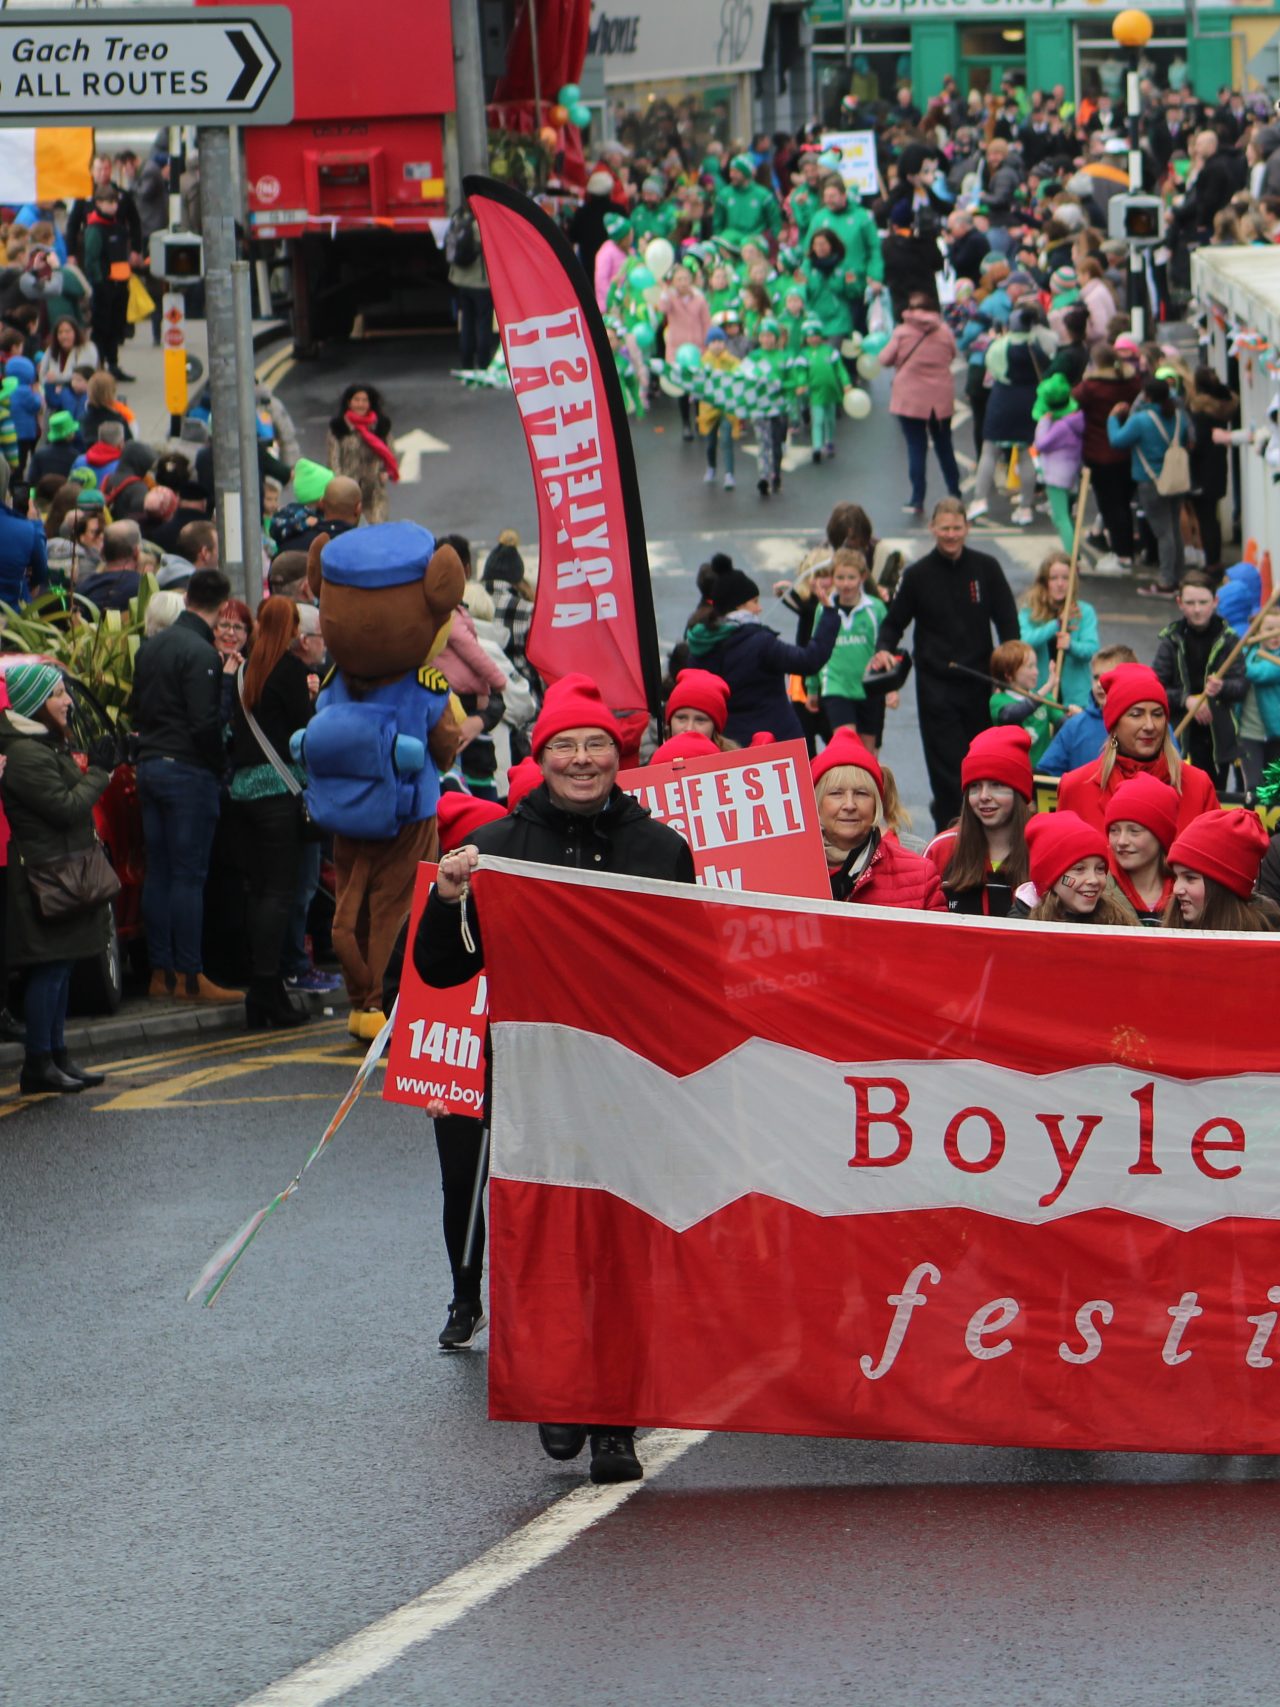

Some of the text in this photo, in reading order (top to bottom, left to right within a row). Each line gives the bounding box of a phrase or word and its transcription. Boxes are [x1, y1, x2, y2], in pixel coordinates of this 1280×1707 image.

[12, 37, 168, 62] Gach Treo
[15, 73, 71, 97] ALL
[83, 71, 208, 96] ROUTES
[408, 1019, 481, 1069] 14th
[844, 1076, 1246, 1207] Boyle
